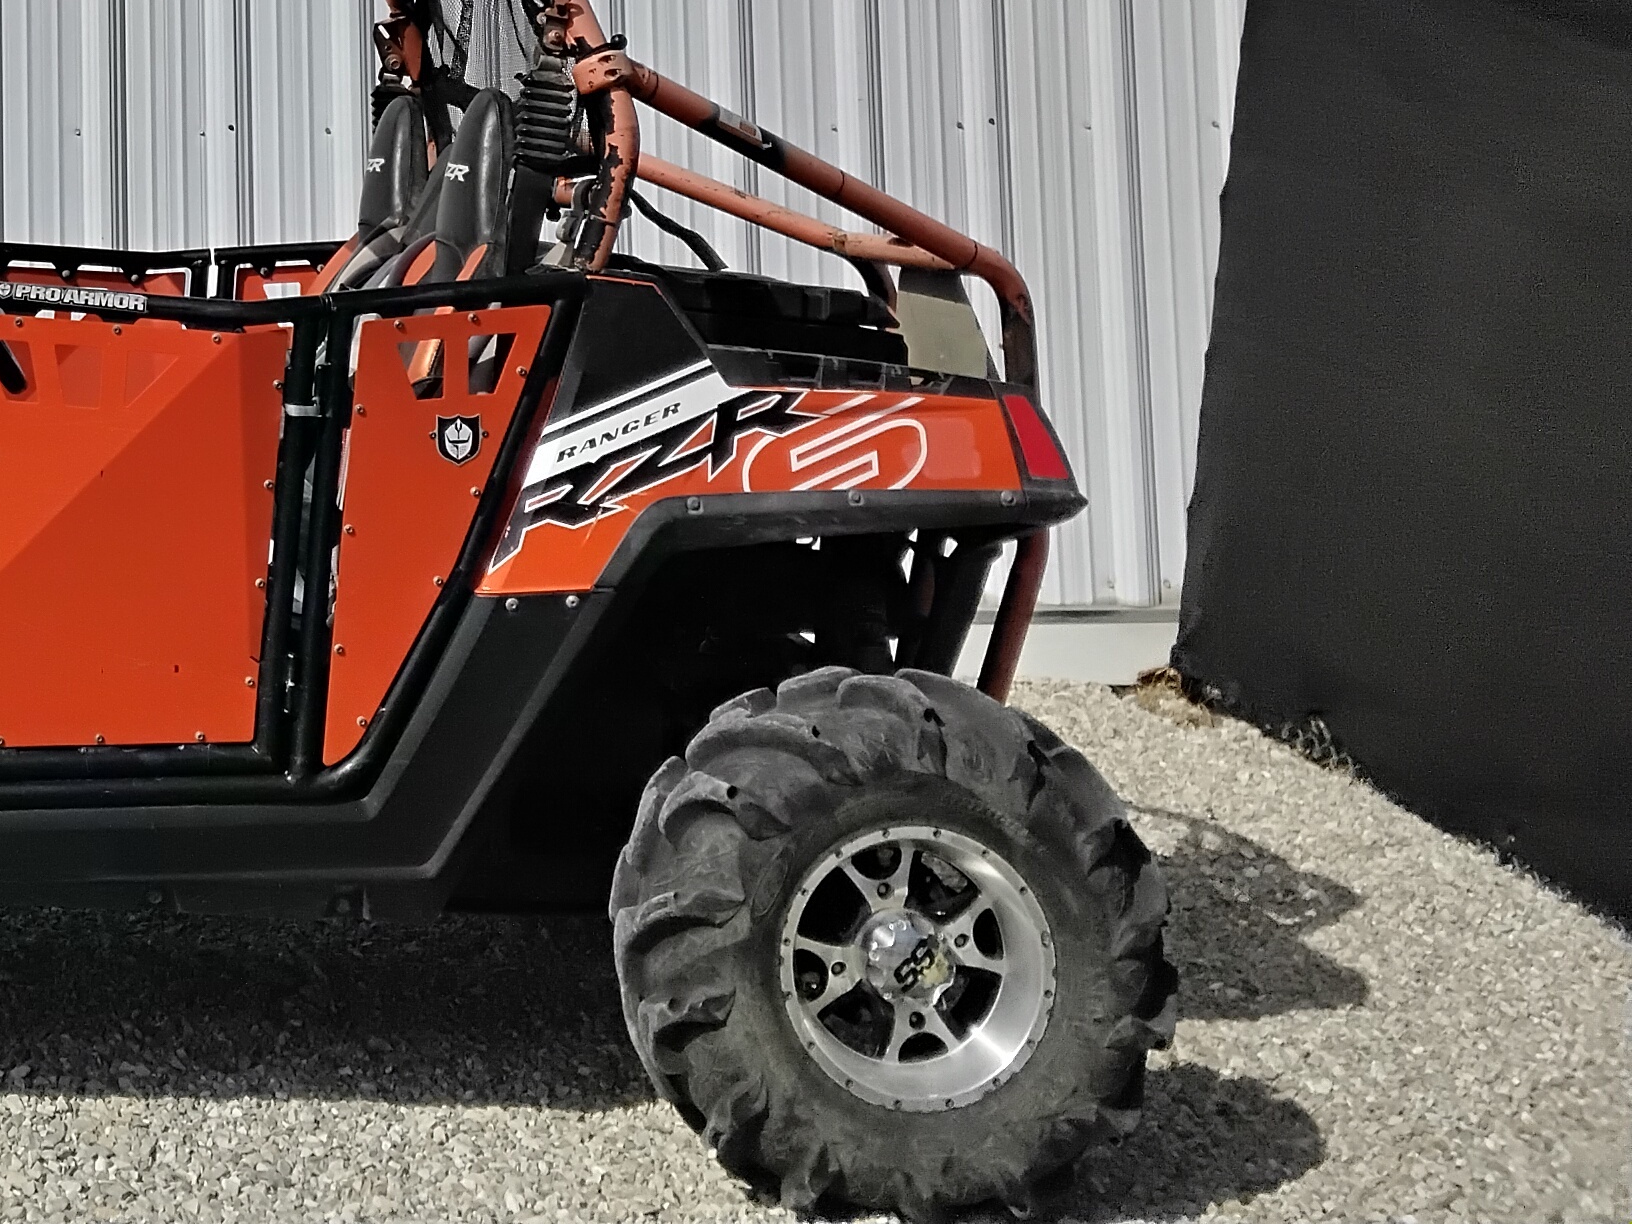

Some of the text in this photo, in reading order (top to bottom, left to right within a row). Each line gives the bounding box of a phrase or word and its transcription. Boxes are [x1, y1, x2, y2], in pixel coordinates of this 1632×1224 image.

[445, 162, 470, 182] ZR
[14, 283, 146, 312] PRO ARMOR
[555, 400, 683, 464] RANGER
[487, 388, 832, 575] RZR
